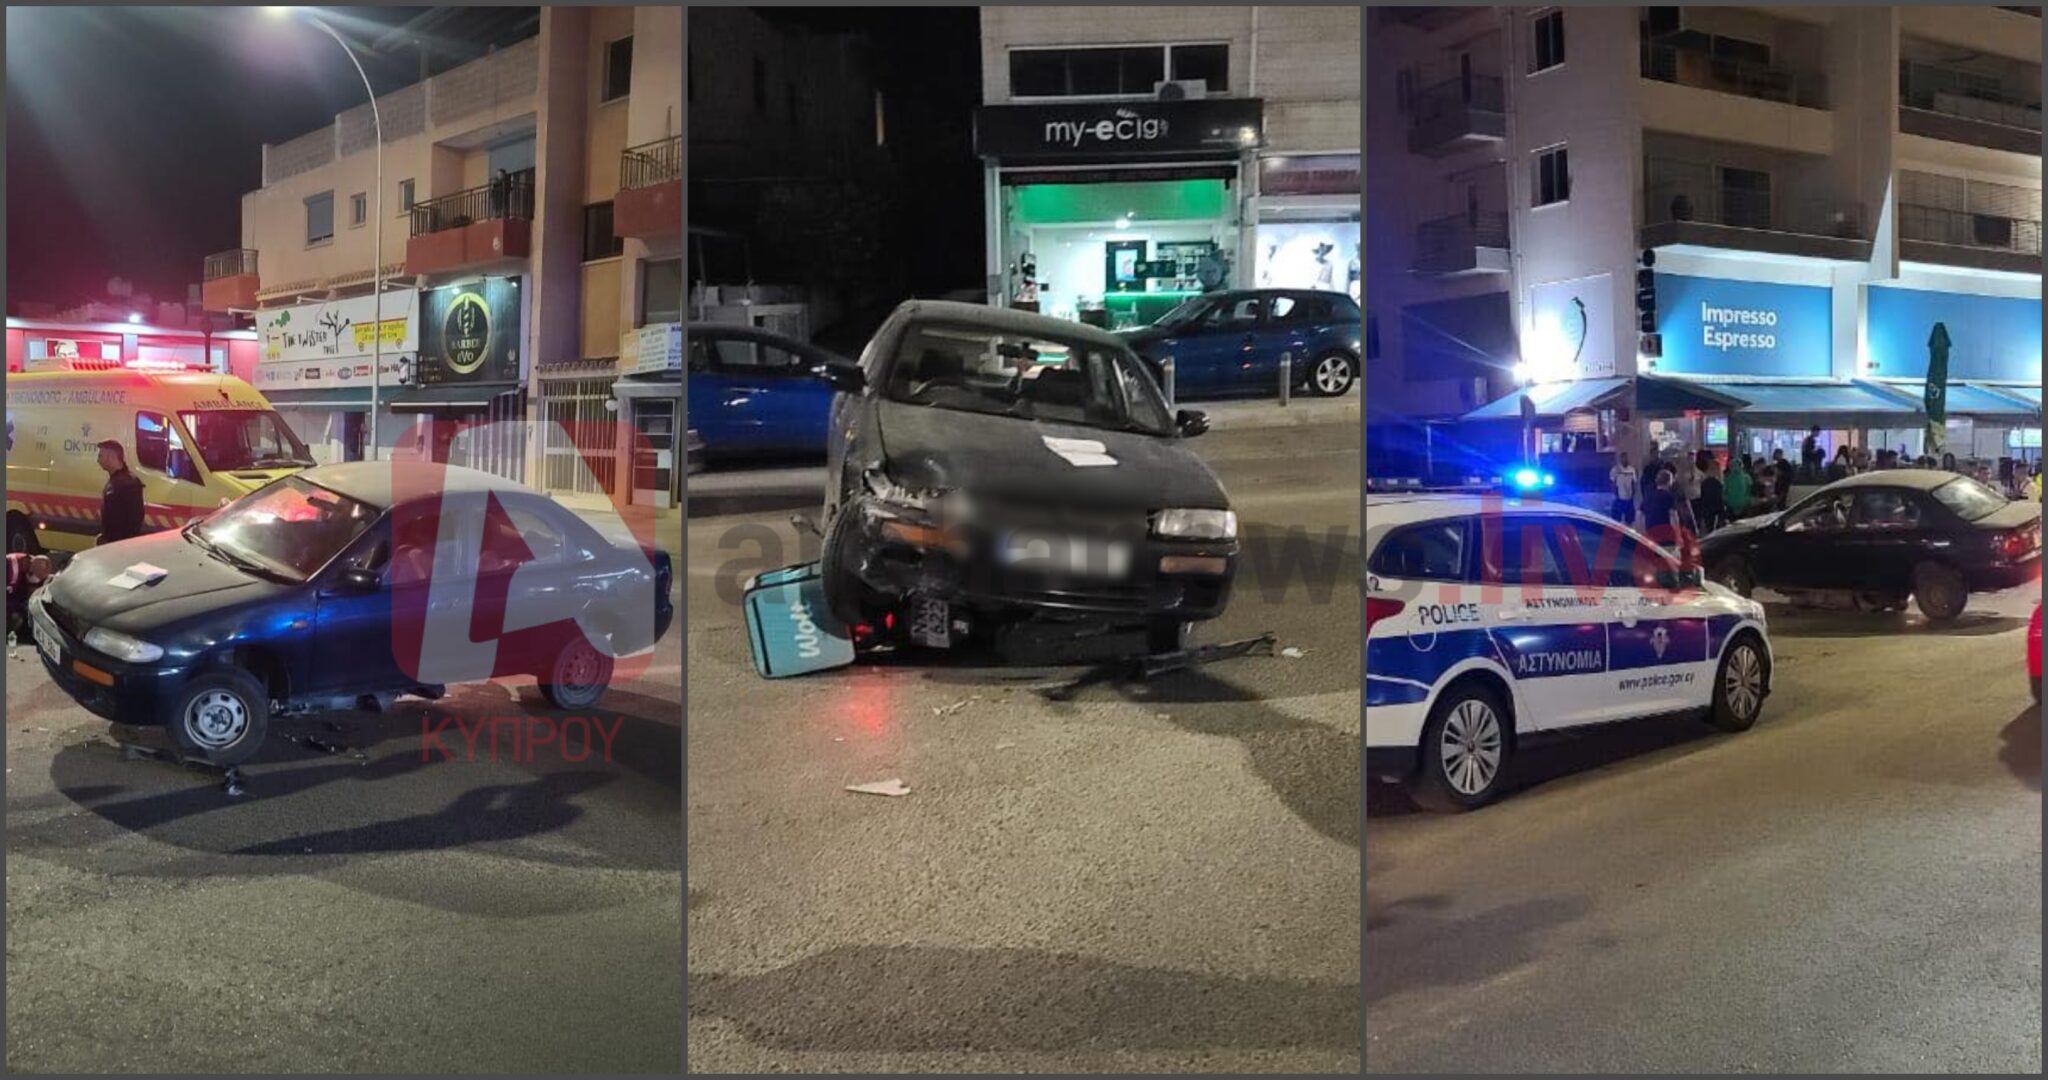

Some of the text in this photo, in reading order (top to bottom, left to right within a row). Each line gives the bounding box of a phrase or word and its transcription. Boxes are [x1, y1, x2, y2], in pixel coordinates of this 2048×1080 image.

[1701, 301, 1778, 327] Impresso
[1703, 325, 1776, 351] Espresso
[1418, 603, 1480, 626] POLICE
[790, 600, 820, 658] Wolt
[1518, 650, 1601, 673] ΑΣΤΥΝΟΜΙΑ
